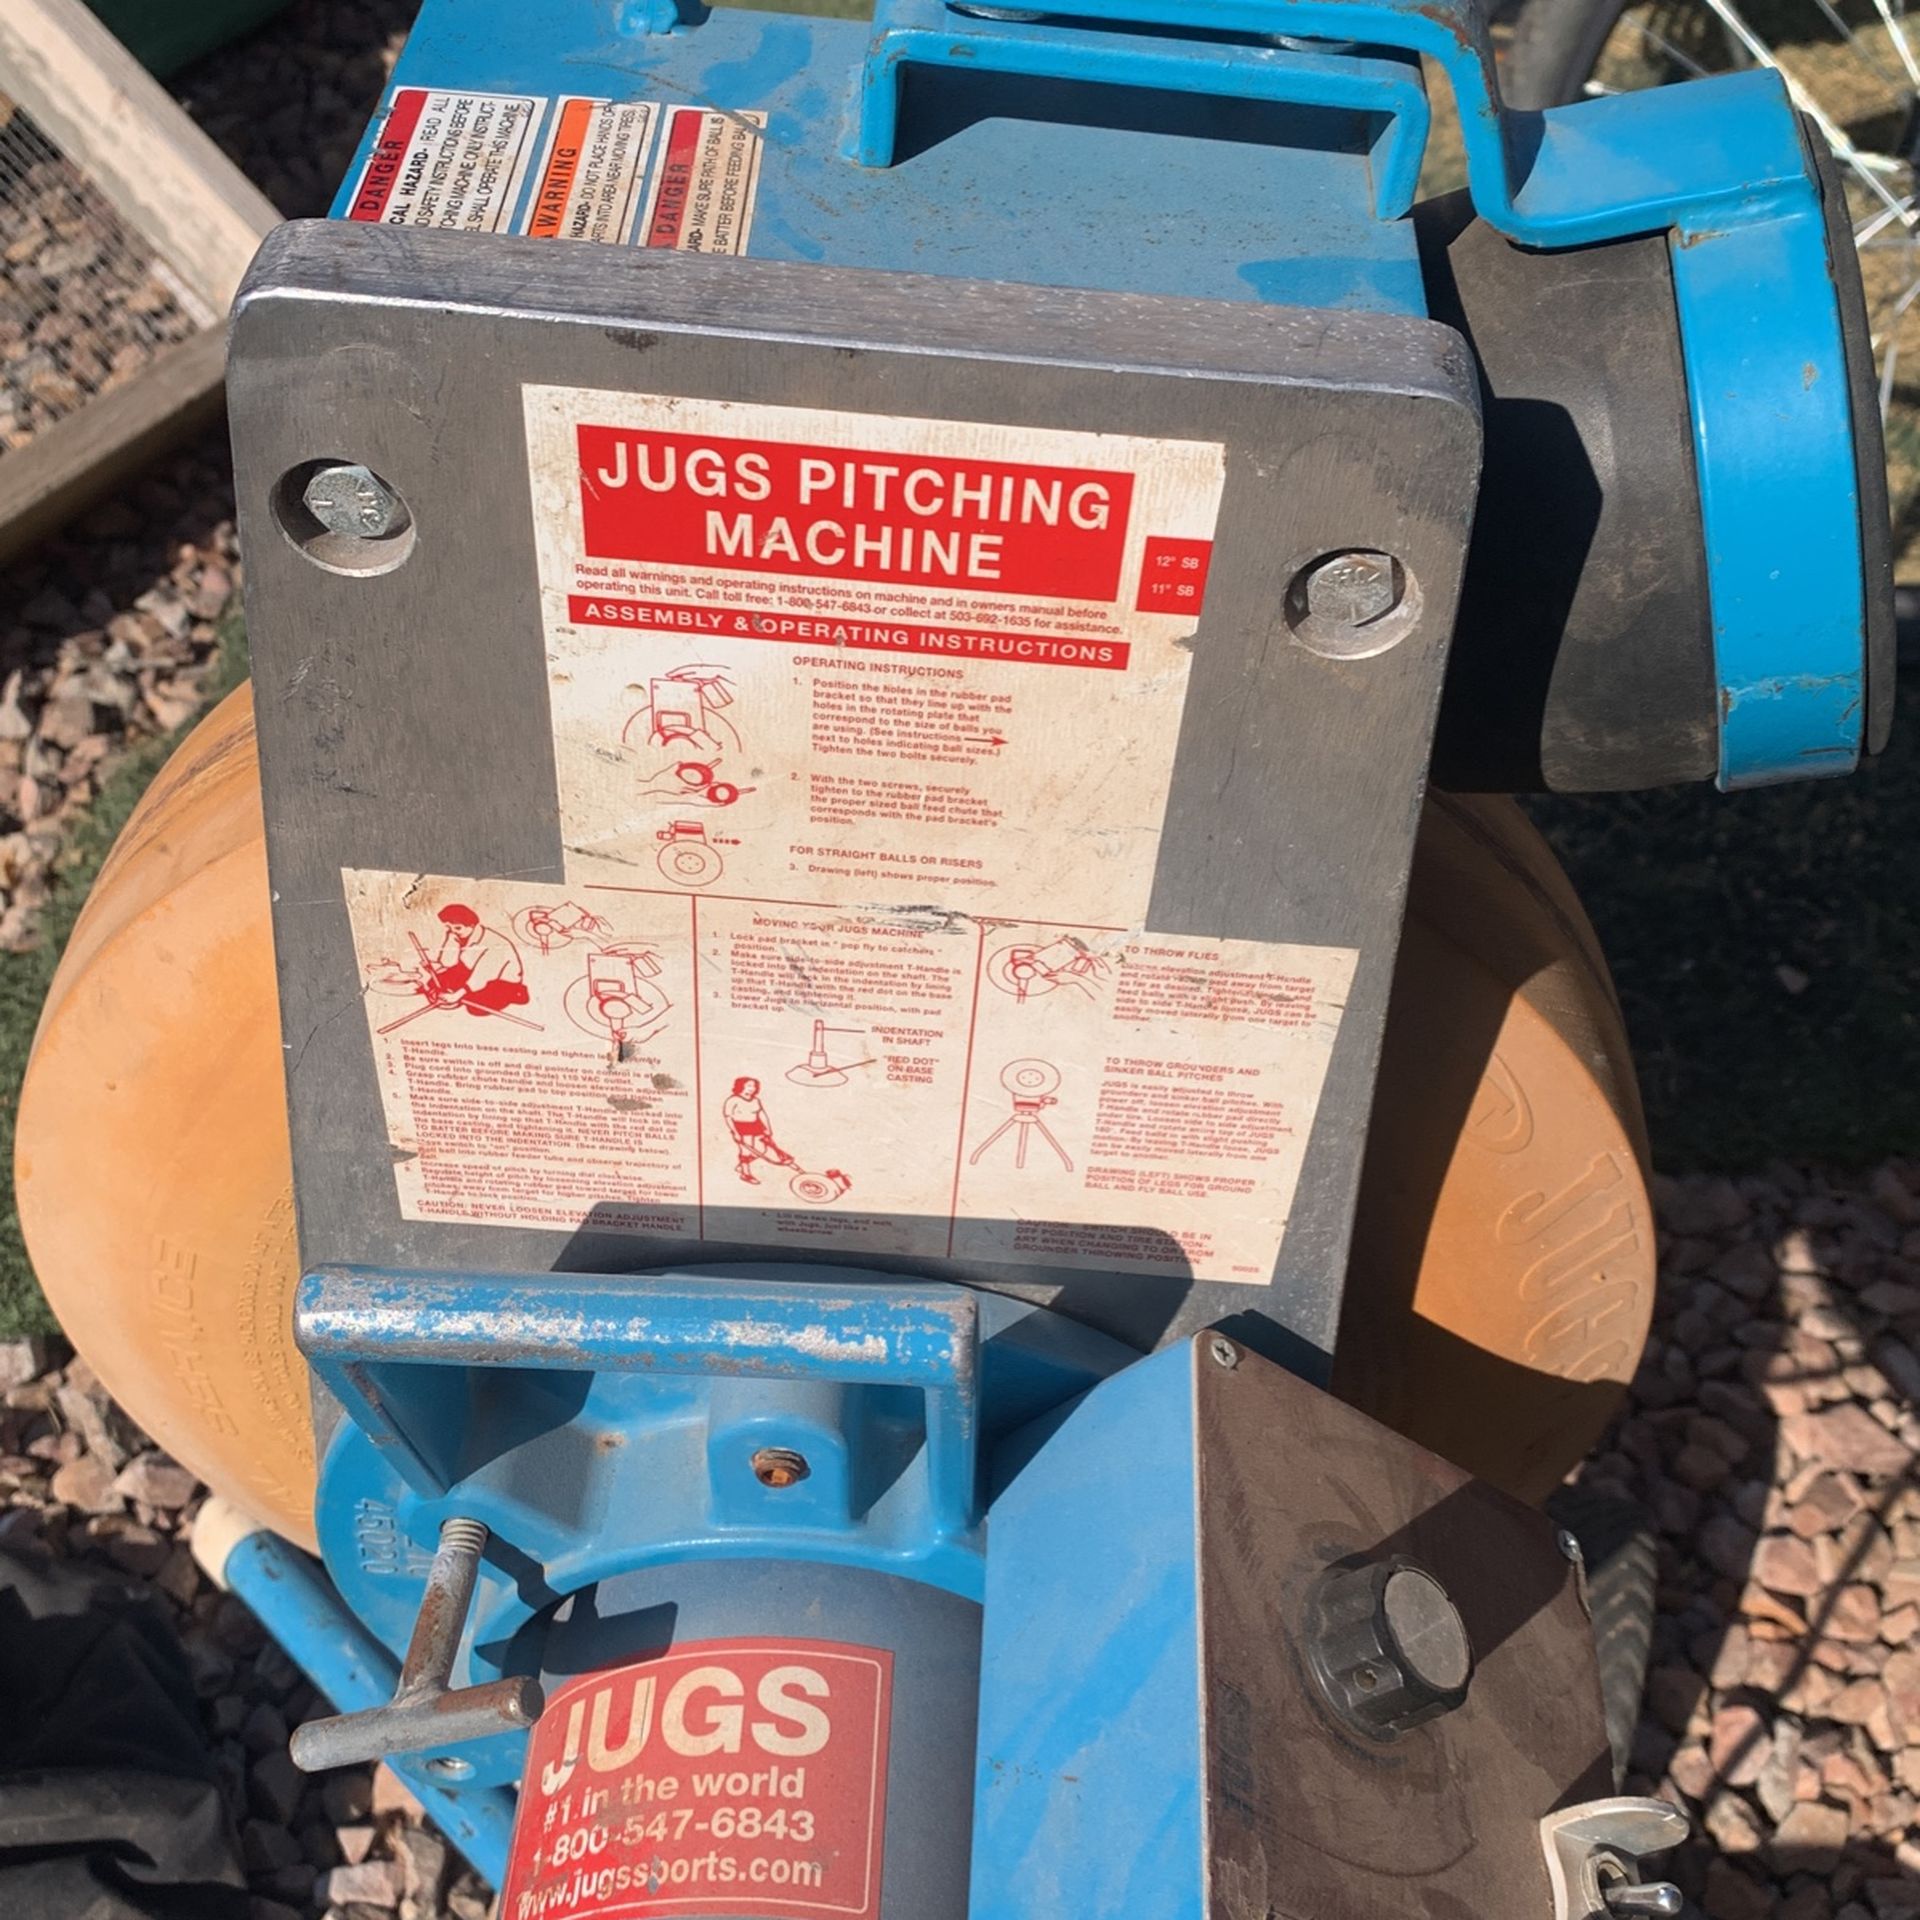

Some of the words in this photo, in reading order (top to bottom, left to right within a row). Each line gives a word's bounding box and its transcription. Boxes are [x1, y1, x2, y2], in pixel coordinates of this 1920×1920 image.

[430, 96, 450, 113] ALL
[420, 116, 443, 141] READ
[359, 140, 404, 211] DANGER
[399, 146, 432, 196] HAZARD-
[536, 148, 576, 227] WARNING
[656, 163, 688, 234] DANGER
[598, 441, 772, 501] JUGS
[799, 458, 1111, 531] PITCHING
[706, 510, 1004, 580] MACHINE
[1182, 557, 1199, 570] SB
[574, 564, 608, 577] Read
[610, 567, 626, 579] all
[628, 568, 686, 587] warnings
[688, 573, 713, 586] and
[715, 575, 776, 595] operating
[778, 581, 852, 598] instructions
[854, 589, 871, 600] on
[873, 589, 927, 605] machine
[929, 593, 953, 607] and
[955, 596, 968, 608] in
[970, 599, 1016, 613] owners
[1018, 601, 1064, 617] manual
[1067, 605, 1108, 620] before
[1177, 585, 1196, 597] SB
[576, 578, 636, 597] operating
[638, 584, 662, 597] this
[664, 586, 692, 599] unit.
[694, 588, 720, 601] Call
[722, 591, 742, 603] toll
[744, 592, 774, 606] free:
[775, 595, 871, 614] 1-800-547-6843
[873, 605, 887, 615] or
[889, 604, 931, 619] collect
[933, 608, 946, 620] at
[948, 609, 1031, 627] 503-692-1635
[1033, 616, 1051, 629] for
[1053, 618, 1124, 634] assistance.
[584, 602, 725, 629] ASSEMBLY
[733, 614, 749, 631] &
[761, 617, 909, 645] OPERATING
[919, 630, 1112, 662] INSTRUCTIONS
[792, 656, 866, 671] OPERATING
[868, 662, 964, 680] INSTRUCTIONS
[812, 678, 859, 691] Position
[860, 681, 880, 693] the
[881, 683, 913, 695] holes
[915, 686, 927, 697] in
[928, 687, 947, 698] the
[949, 689, 987, 701] rubber
[989, 692, 1012, 706] pad
[812, 690, 856, 703] bracket
[858, 695, 872, 704] so
[874, 694, 898, 706] that
[899, 696, 925, 710] they
[926, 698, 948, 710] line
[949, 702, 965, 713] up
[967, 701, 992, 713] with
[993, 703, 1012, 714] the
[812, 700, 843, 712] holes
[845, 702, 856, 713] in
[858, 703, 877, 714] the
[879, 705, 924, 721] rotating
[926, 708, 954, 723] plate
[956, 711, 980, 722] that
[812, 712, 876, 728] correspond
[877, 716, 890, 727] to
[892, 717, 911, 728] the
[913, 719, 936, 730] size
[938, 721, 950, 731] of
[952, 722, 979, 734] balls
[981, 726, 1004, 738] you
[812, 723, 830, 733] are
[895, 728, 962, 744] instructions
[812, 732, 836, 744] next
[837, 734, 850, 745] to
[852, 735, 883, 748] holes
[884, 738, 940, 754] indicating
[941, 742, 963, 754] ball
[788, 846, 814, 857] FOR
[816, 847, 876, 862] STRAIGHT
[877, 852, 917, 865] BALLS
[918, 855, 937, 866] OR
[939, 856, 984, 870] RISERS
[808, 864, 851, 879] Drawing
[879, 869, 913, 881] shows
[915, 874, 950, 886] proper
[752, 917, 799, 930] MOVING
[801, 920, 835, 932] YOUR
[836, 923, 868, 935] JUGS
[870, 926, 924, 939] MACHINE
[1124, 945, 1140, 955] TO
[1142, 947, 1185, 959] THROW
[1186, 950, 1219, 962] FLIES
[871, 1026, 944, 1038] INDENTATION
[881, 1037, 893, 1045] IN
[895, 1038, 931, 1047] SHAFT
[886, 1065, 903, 1074] ON
[905, 1066, 934, 1076] BASE
[886, 1073, 934, 1084] CASTING
[1105, 1057, 1121, 1066] TO
[1122, 1058, 1163, 1069] THROW
[1165, 1061, 1234, 1074] GROUNDERS
[1236, 1066, 1260, 1076] AND
[541, 1665, 831, 1796] JUGS
[581, 1786, 609, 1819] in
[620, 1773, 680, 1806] the
[690, 1766, 806, 1799] world
[532, 1807, 816, 1878] 1-800-547-6843
[516, 1850, 823, 1920] www.jugssports.com
